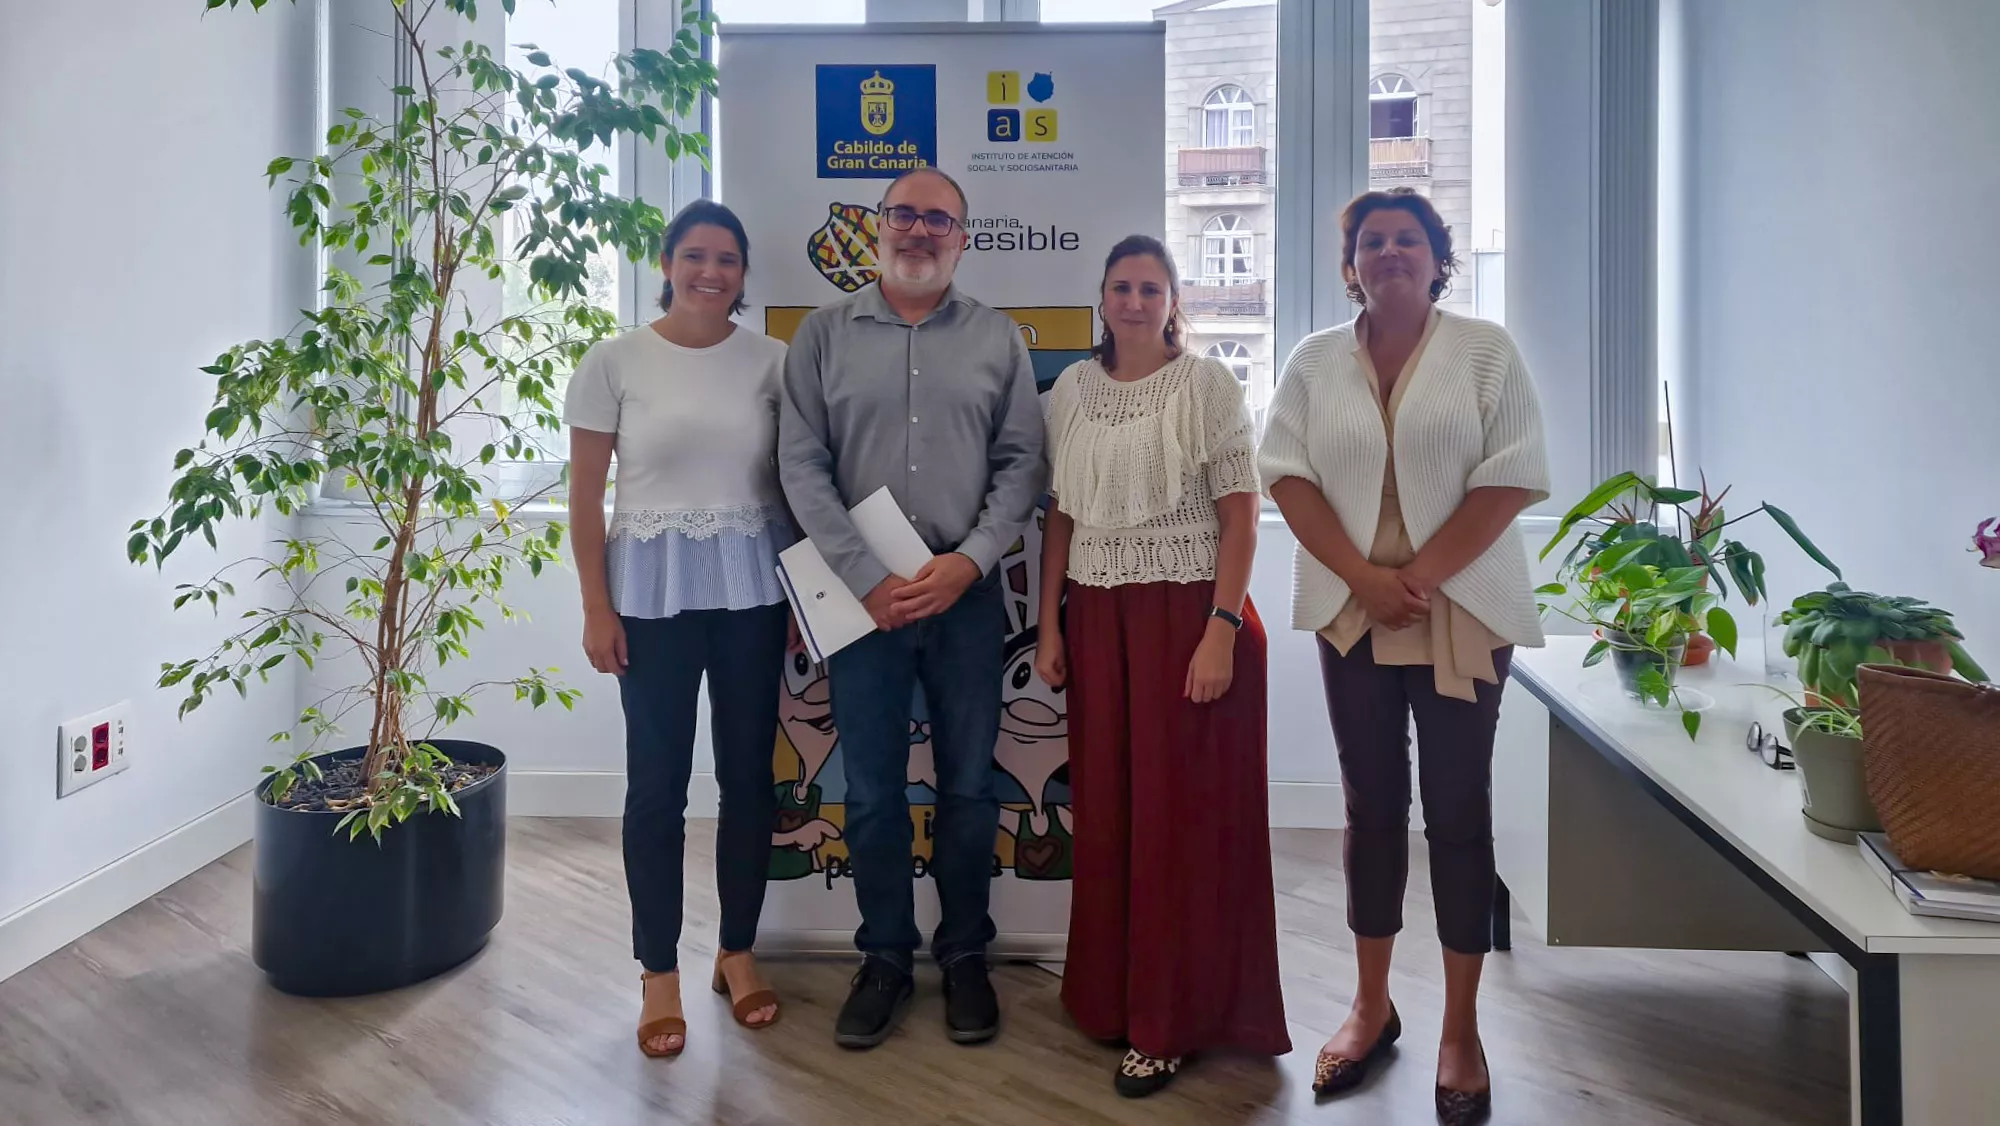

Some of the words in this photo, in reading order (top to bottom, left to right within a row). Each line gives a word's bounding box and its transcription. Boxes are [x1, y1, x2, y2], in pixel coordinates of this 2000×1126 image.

[834, 140, 894, 154] Cabildo
[897, 140, 917, 154] de
[971, 152, 1015, 160] INSTITUTO
[1017, 152, 1029, 160] DE
[1031, 151, 1074, 160] ATENCIÓN
[827, 156, 865, 169] Gran
[868, 156, 927, 169] Canaria
[967, 164, 997, 172] SOCIAL
[1000, 164, 1005, 172] Y
[1007, 164, 1079, 172] SOCIOSANITARIA
